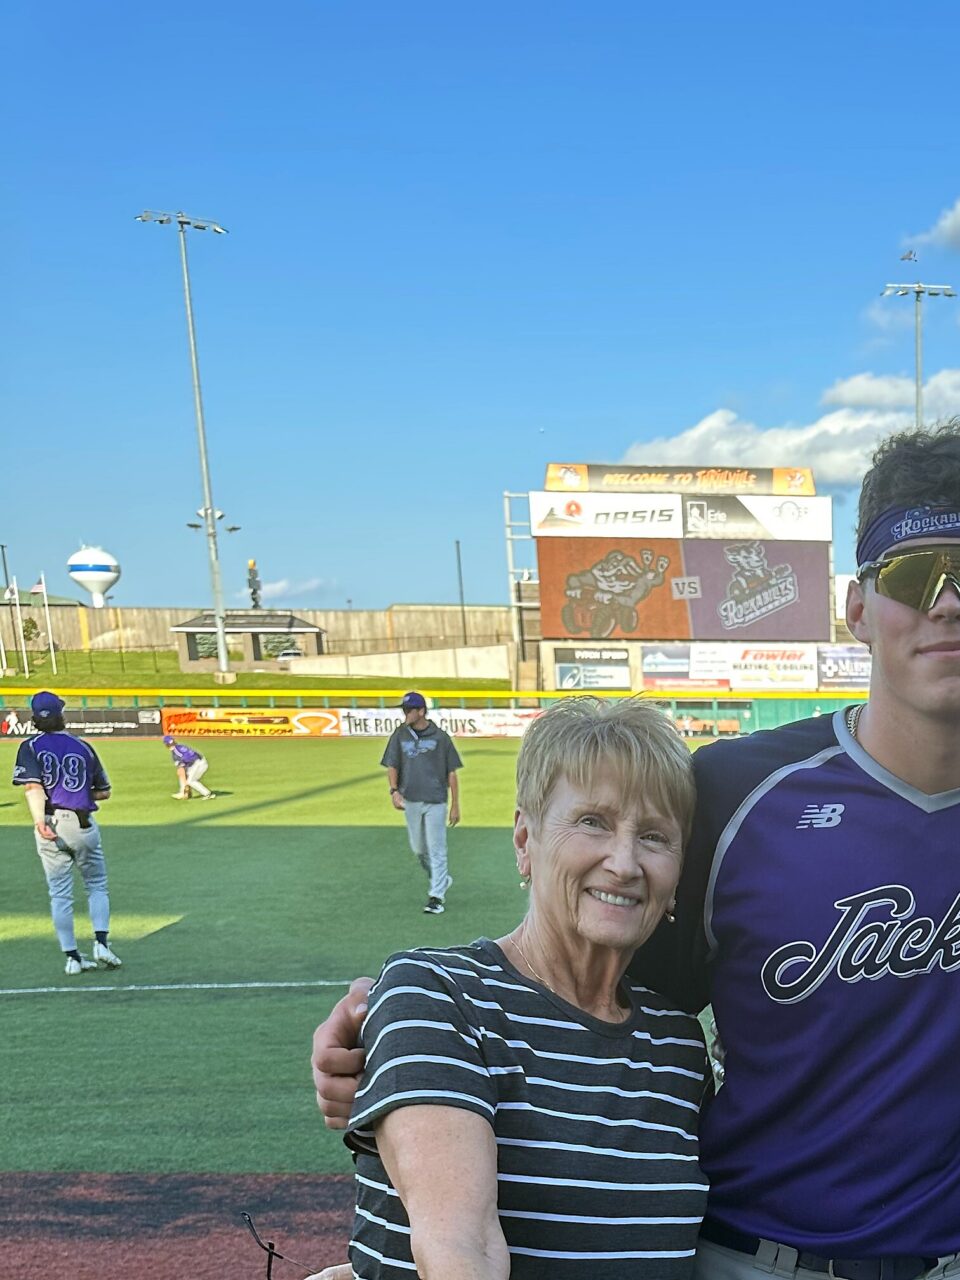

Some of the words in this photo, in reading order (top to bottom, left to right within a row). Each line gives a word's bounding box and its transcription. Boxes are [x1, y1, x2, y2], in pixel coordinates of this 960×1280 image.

[602, 473, 669, 486] WELCOME
[673, 473, 693, 485] TO
[594, 508, 674, 525] OASIS
[674, 581, 698, 595] VS
[740, 649, 806, 661] Fowler
[342, 711, 370, 735] THE
[375, 718, 401, 733] ROO
